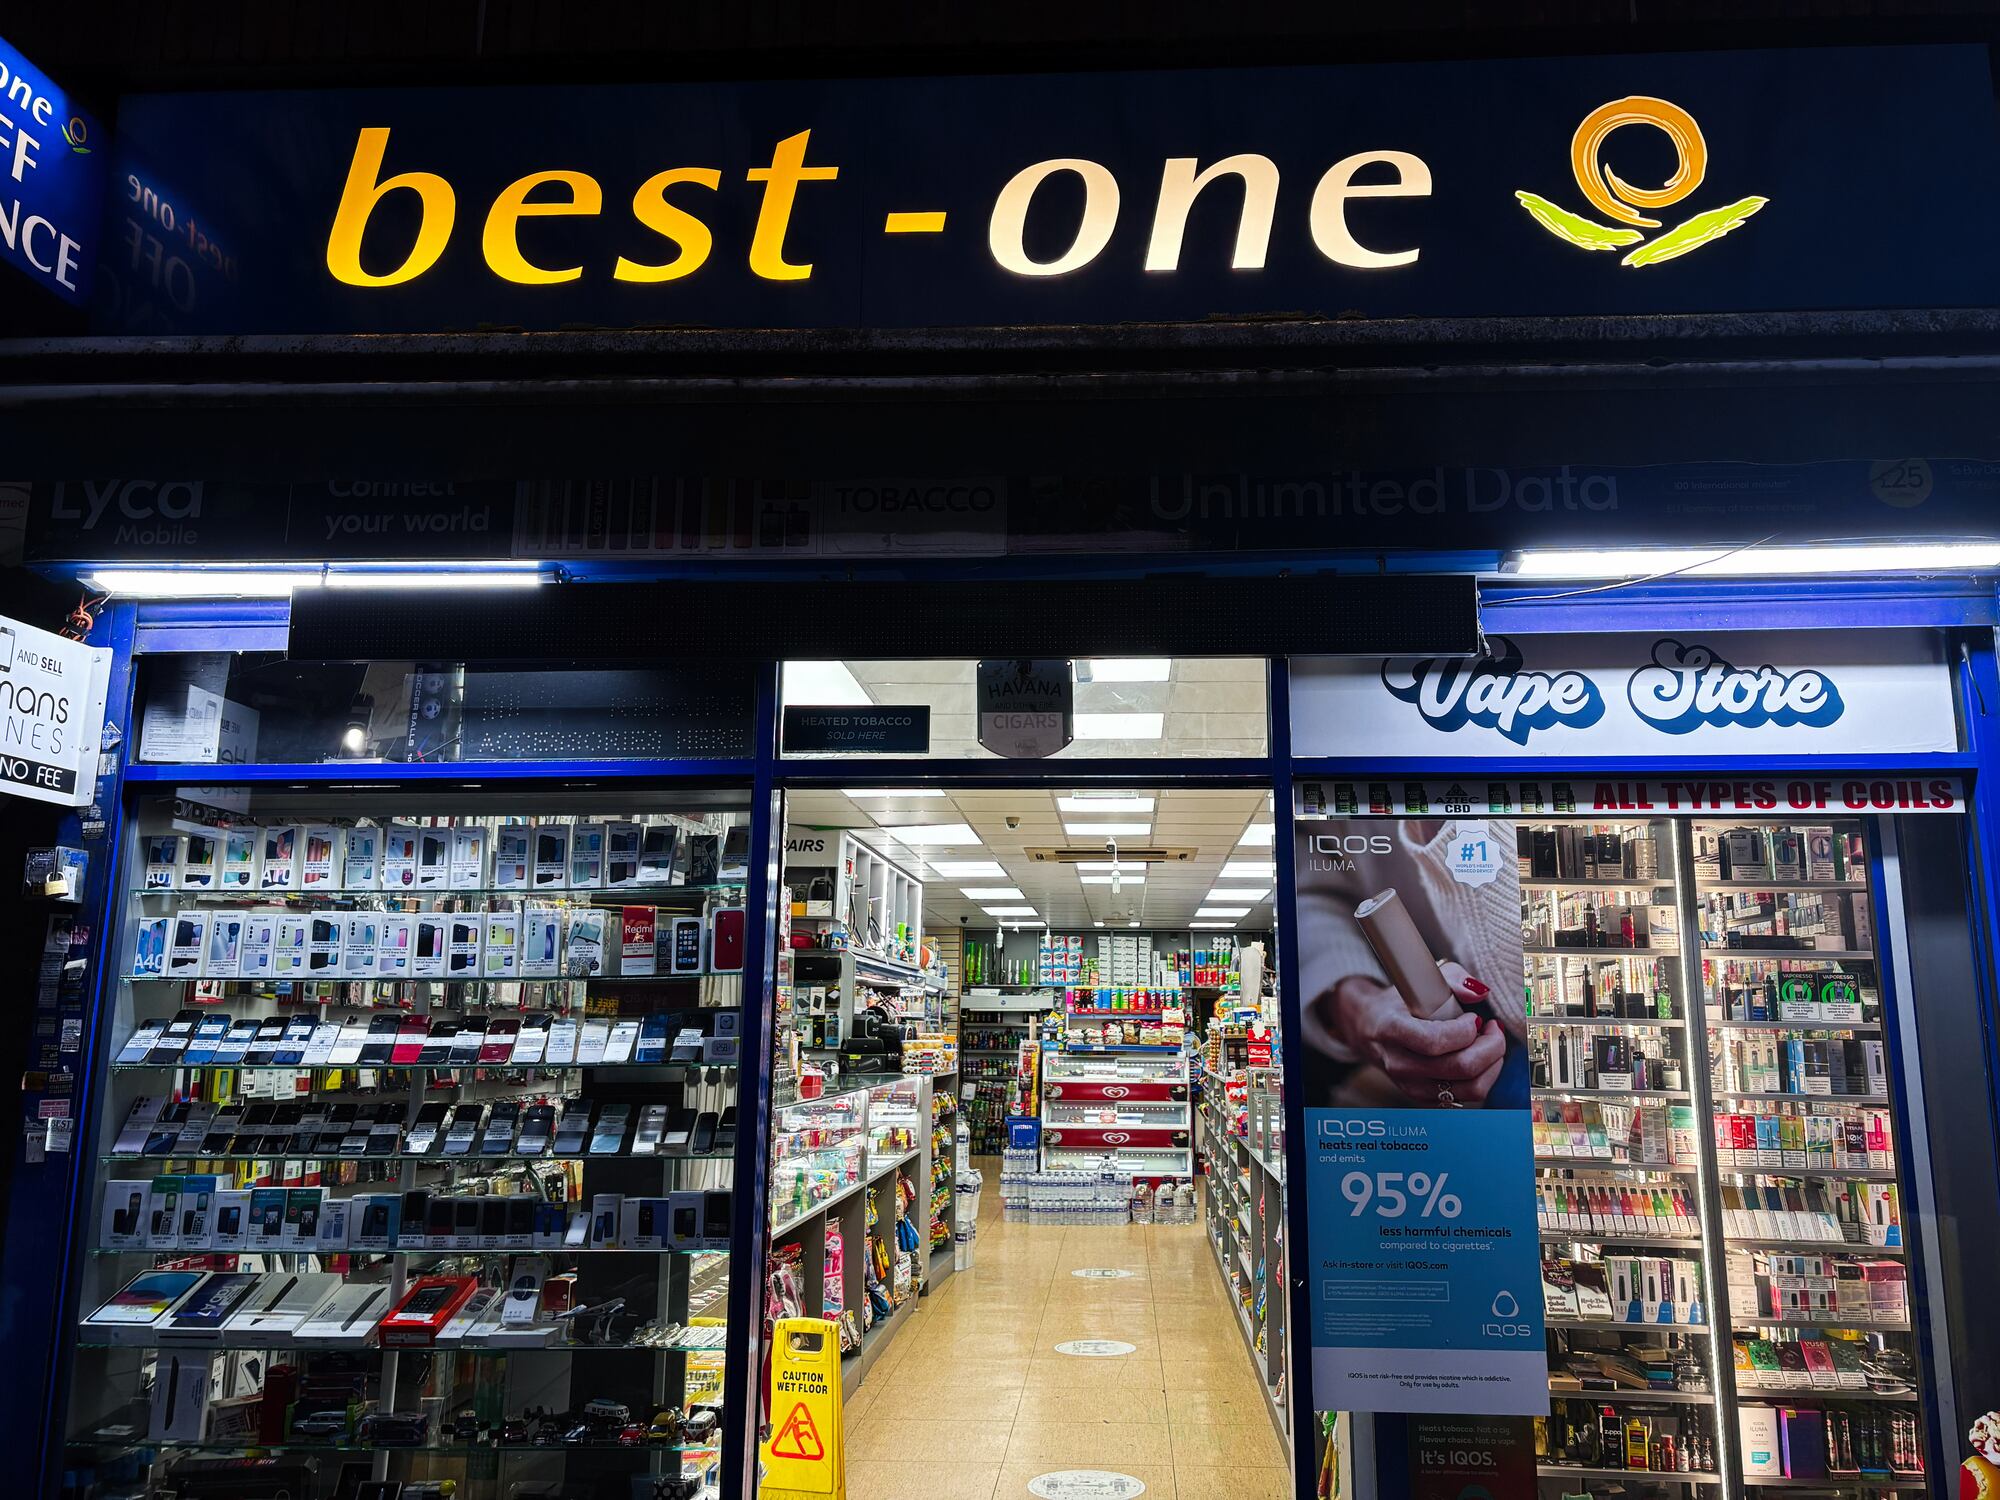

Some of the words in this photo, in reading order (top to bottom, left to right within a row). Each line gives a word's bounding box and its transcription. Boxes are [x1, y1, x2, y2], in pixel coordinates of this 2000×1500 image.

[326, 125, 839, 286] best
[987, 148, 1436, 277] one
[1150, 464, 1446, 520] Unlimited
[1464, 464, 1619, 513] Data
[835, 487, 995, 513] TOBACCO
[324, 510, 393, 540] your
[404, 505, 490, 534] world
[113, 525, 198, 545] Mobile
[16, 649, 38, 666] AND
[40, 656, 63, 675] SELL
[988, 680, 1061, 698] HAVANA
[1381, 638, 1605, 746] Vape
[1626, 638, 1844, 736] Store
[801, 716, 849, 726] HEATED
[852, 716, 912, 726] TOBACCO
[993, 714, 1057, 729] CIGARS
[408, 712, 418, 747] BALLS
[827, 731, 856, 740] SOLD
[858, 731, 887, 740] HERE
[36, 766, 63, 788] FEE
[1435, 795, 1480, 804] AZTEC
[1593, 783, 1655, 810] ALL
[1661, 781, 1779, 810] TYPES
[1787, 781, 1835, 809] OF
[1843, 780, 1955, 809] COILS
[1445, 804, 1470, 813] CBD
[784, 839, 825, 852] AIRS
[1309, 835, 1393, 857] IQOS
[1461, 841, 1487, 861] #1
[1309, 859, 1356, 872] ILUMA
[624, 925, 653, 934] Redmi
[1317, 1119, 1386, 1138] IQOS
[1388, 1126, 1428, 1137] ILUMA
[1319, 1140, 1353, 1150] heats
[1355, 1140, 1377, 1150] real
[1380, 1140, 1429, 1151] tobacco
[1319, 1154, 1337, 1163] and
[1339, 1154, 1366, 1163] emits
[1341, 1171, 1462, 1218] 95%
[1379, 1226, 1402, 1237] less
[1405, 1226, 1450, 1237] harmful
[1454, 1226, 1512, 1238] chemicals
[1380, 1240, 1427, 1251] compared
[1430, 1241, 1440, 1250] to
[1323, 1260, 1338, 1269] Ask
[1340, 1260, 1374, 1269] in-store
[1386, 1260, 1403, 1269] visit
[1405, 1261, 1448, 1270] IQOS.com
[1482, 1324, 1531, 1338] IQOS
[782, 1370, 824, 1383] CAUTION
[1379, 1373, 1403, 1381] risk-free
[1415, 1374, 1438, 1383] provides
[1484, 1375, 1511, 1383] addictive.
[777, 1382, 797, 1393] WET
[797, 1383, 828, 1395] FLOOR
[1399, 1381, 1413, 1389] Only
[1420, 1450, 1446, 1465] It's
[1449, 1450, 1497, 1466] IQOS.
